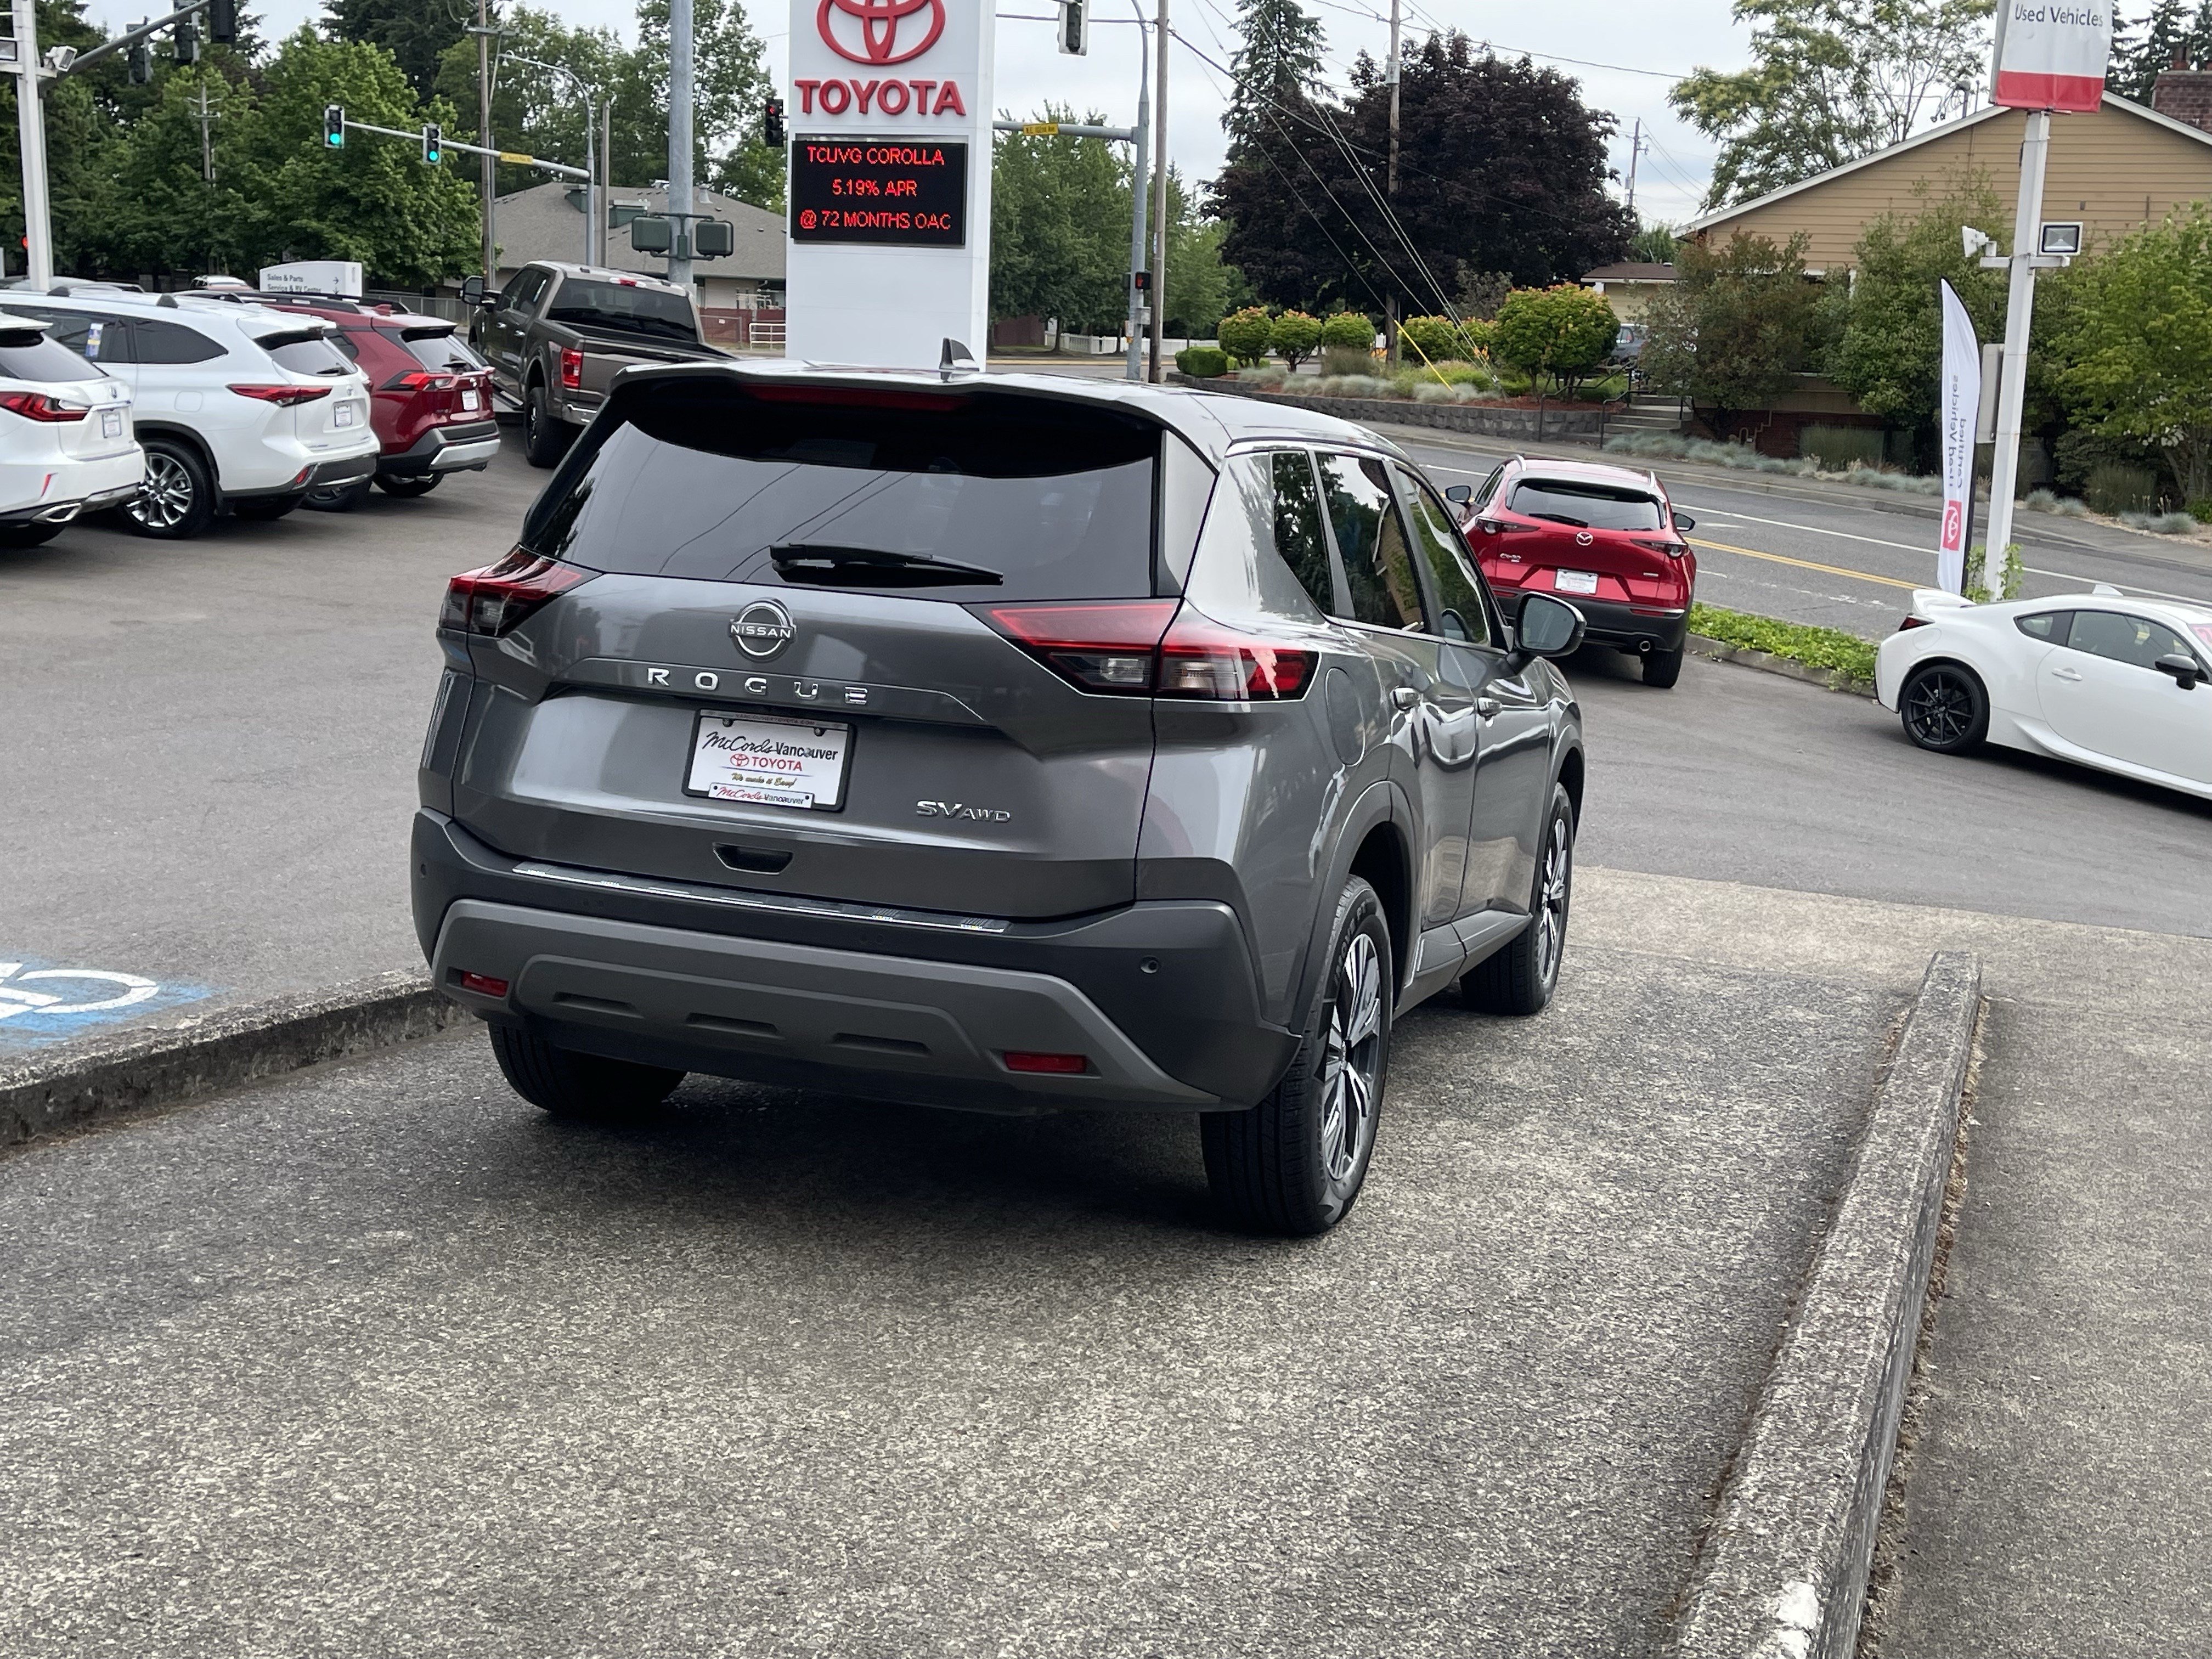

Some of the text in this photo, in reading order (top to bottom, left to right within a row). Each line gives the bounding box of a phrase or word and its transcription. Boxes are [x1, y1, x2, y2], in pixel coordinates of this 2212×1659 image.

[2015, 3, 2103, 27] Used Vehicles
[794, 79, 966, 116] TOYOTA
[866, 147, 945, 166] COROLLA
[832, 178, 918, 197] 5.19% APR
[800, 209, 952, 230] @ 72 MONTHS OAC
[731, 624, 791, 639] NISSAN
[647, 668, 868, 705] ROGUE
[776, 741, 838, 761] Vancouver
[752, 756, 803, 772] TOYOTA
[764, 793, 805, 805] Vancouver
[917, 800, 1011, 823] SV AWD
